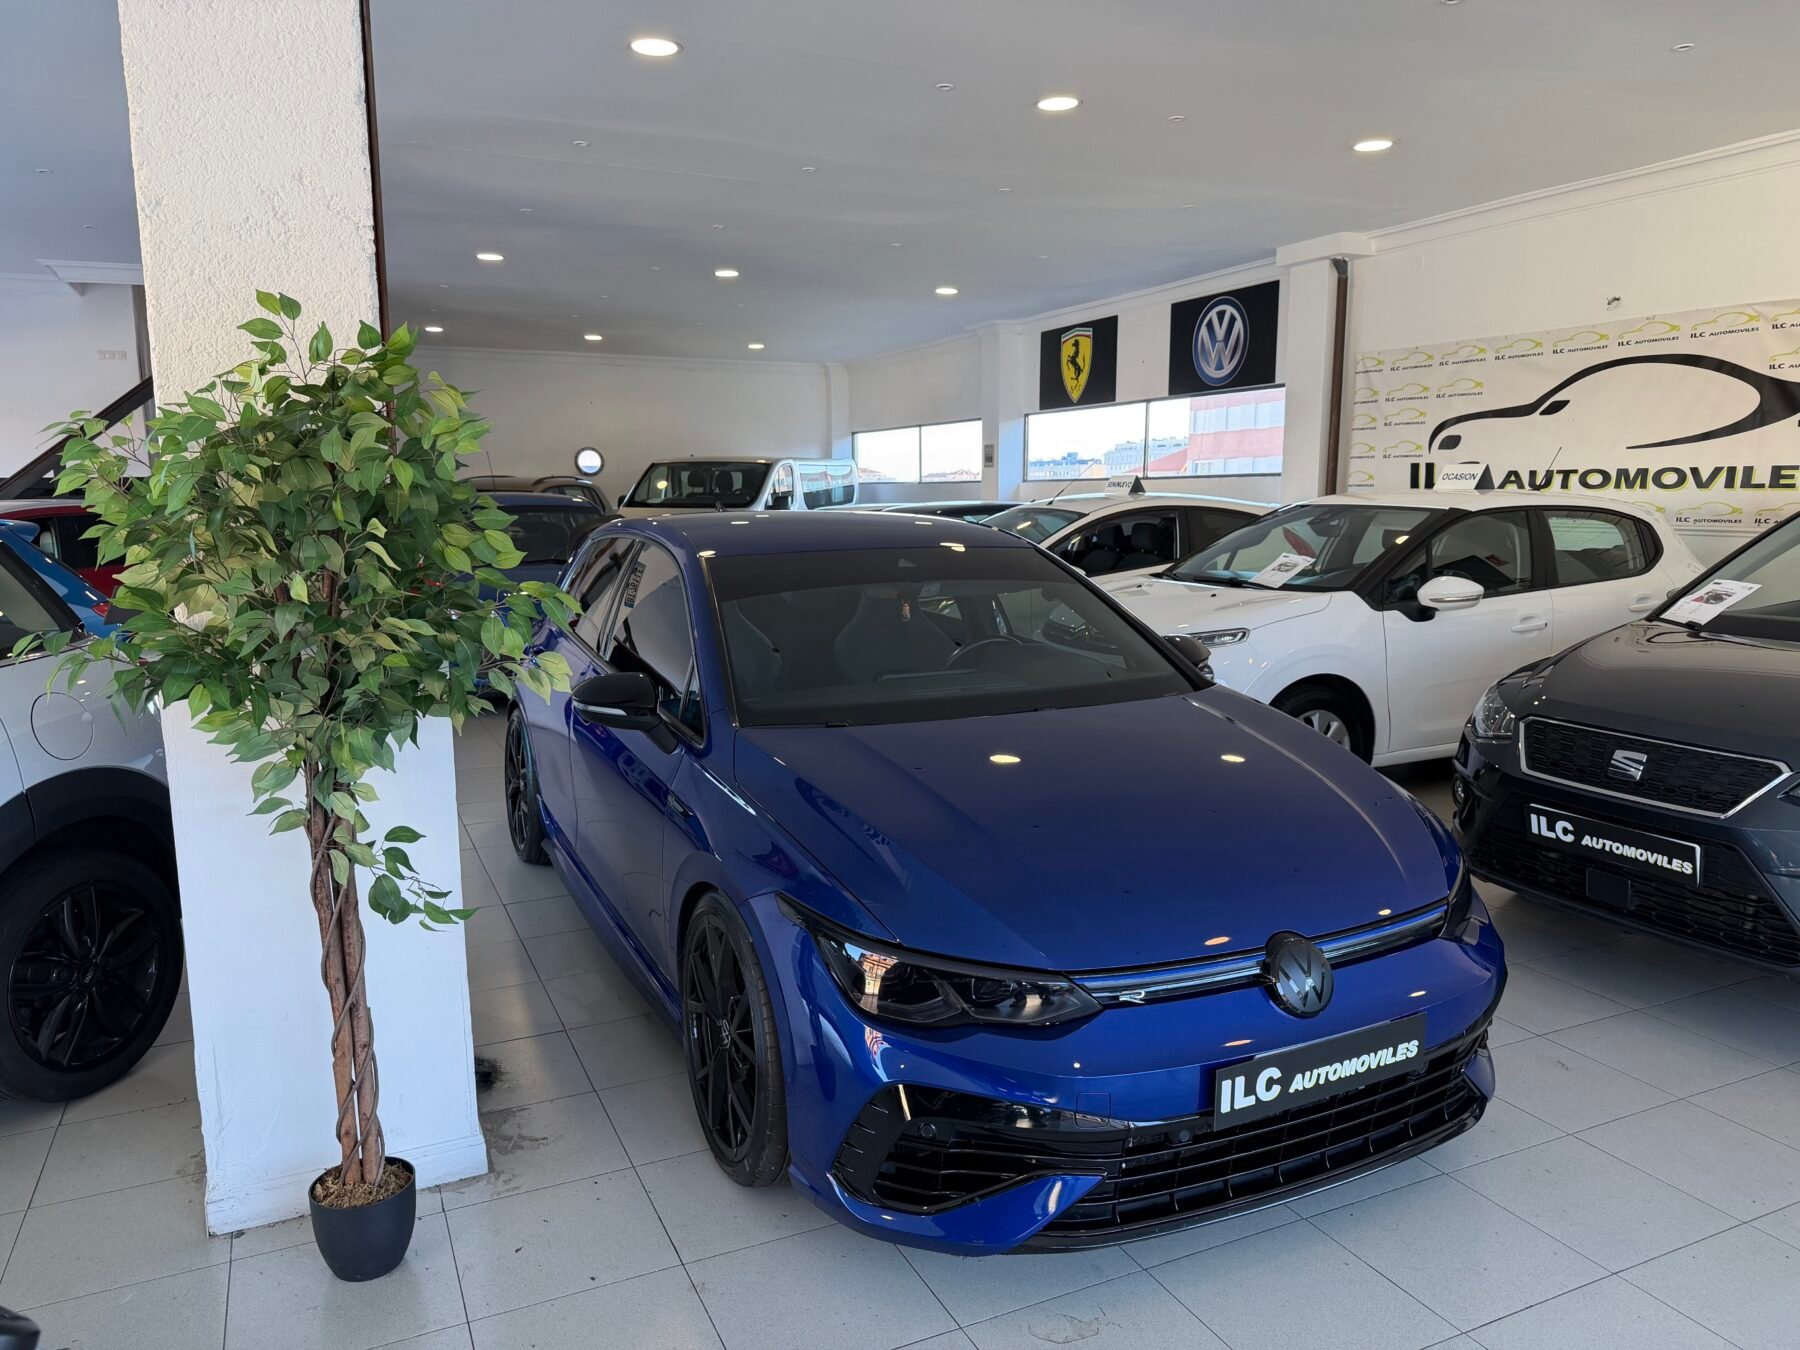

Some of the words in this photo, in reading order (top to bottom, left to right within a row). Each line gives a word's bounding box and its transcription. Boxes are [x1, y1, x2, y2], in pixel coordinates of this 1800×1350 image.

[1708, 327, 1760, 337] AUTOMOVILES
[1634, 336, 1680, 345] AUTOMOVILES
[1567, 345, 1608, 353] AUTOMOVILES
[1442, 472, 1478, 481] OCASION
[1530, 814, 1575, 842] ILC
[1581, 834, 1694, 875] AUTOMOVILES
[1220, 1066, 1283, 1114] ILC
[1288, 1040, 1420, 1094] AUTOMOVILES
